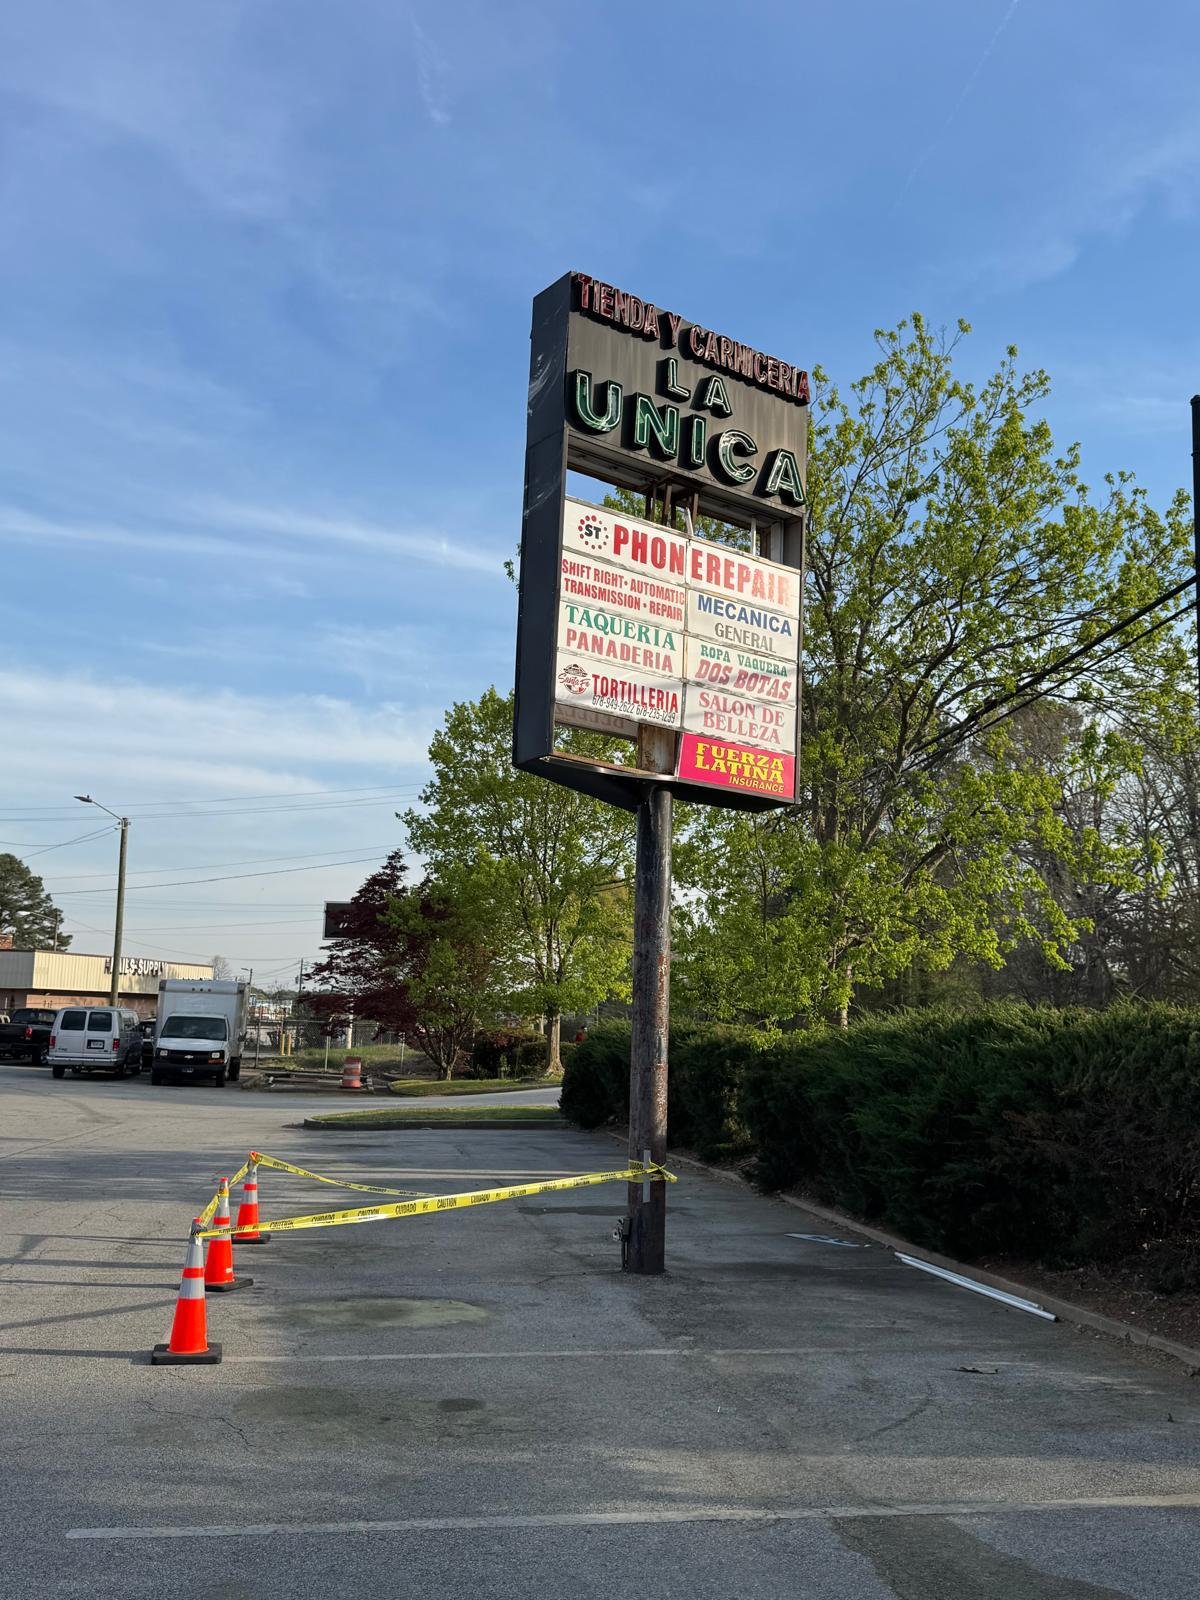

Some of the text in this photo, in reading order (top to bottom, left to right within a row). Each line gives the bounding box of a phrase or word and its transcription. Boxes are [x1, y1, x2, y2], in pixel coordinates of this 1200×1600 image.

[577, 272, 811, 402] TIENDA Y CARNICERIA
[664, 356, 733, 418] LA
[572, 369, 806, 505] UNICA
[584, 523, 602, 540] ST
[561, 558, 685, 606] SHIFT RIGHT AUTOMATIC
[564, 577, 683, 622] TRANSMISSION REPAIR
[565, 604, 676, 652] TAQUERIA
[697, 594, 792, 637] MECANICA
[565, 628, 673, 673] PANADERIA
[714, 622, 777, 654] GENERAL
[695, 660, 792, 701] DOS BOTAS
[700, 644, 788, 677] ROPA VAQUERA
[591, 673, 679, 714] TORTILLERIA
[698, 691, 785, 728] SALON DE
[703, 711, 781, 744] BELLEZA
[695, 742, 785, 771] FUERZA
[695, 754, 785, 784] LATINA
[728, 776, 785, 793] INSURANCE
[436, 1197, 457, 1209] CAUTION
